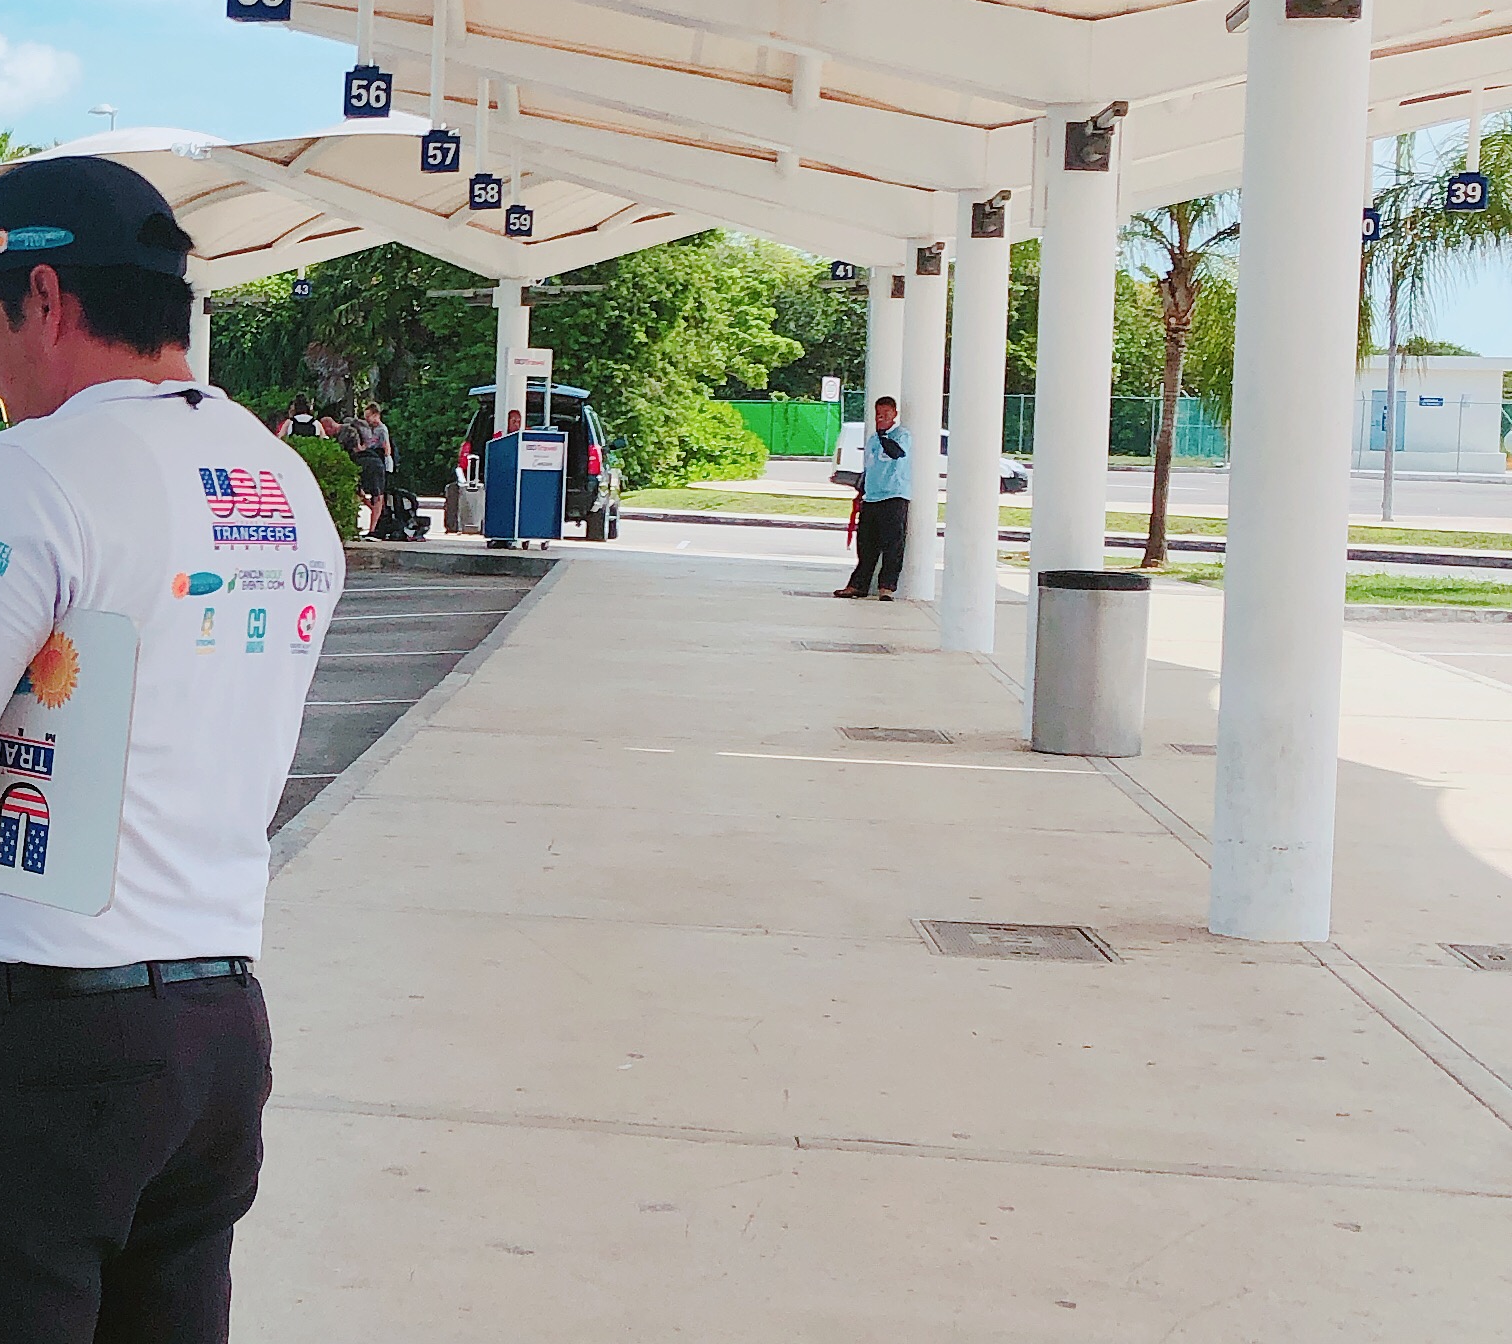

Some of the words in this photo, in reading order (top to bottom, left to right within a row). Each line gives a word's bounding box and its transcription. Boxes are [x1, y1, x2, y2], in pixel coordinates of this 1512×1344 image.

[350, 79, 387, 108] 56
[427, 142, 457, 166] 57
[473, 183, 499, 203] 58
[1450, 182, 1483, 204] 39
[509, 213, 531, 231] 59
[1362, 218, 1375, 236] 0
[835, 264, 854, 278] 41
[294, 284, 309, 295] 43
[198, 467, 295, 519] USA
[214, 526, 295, 541] TRANSFERS
